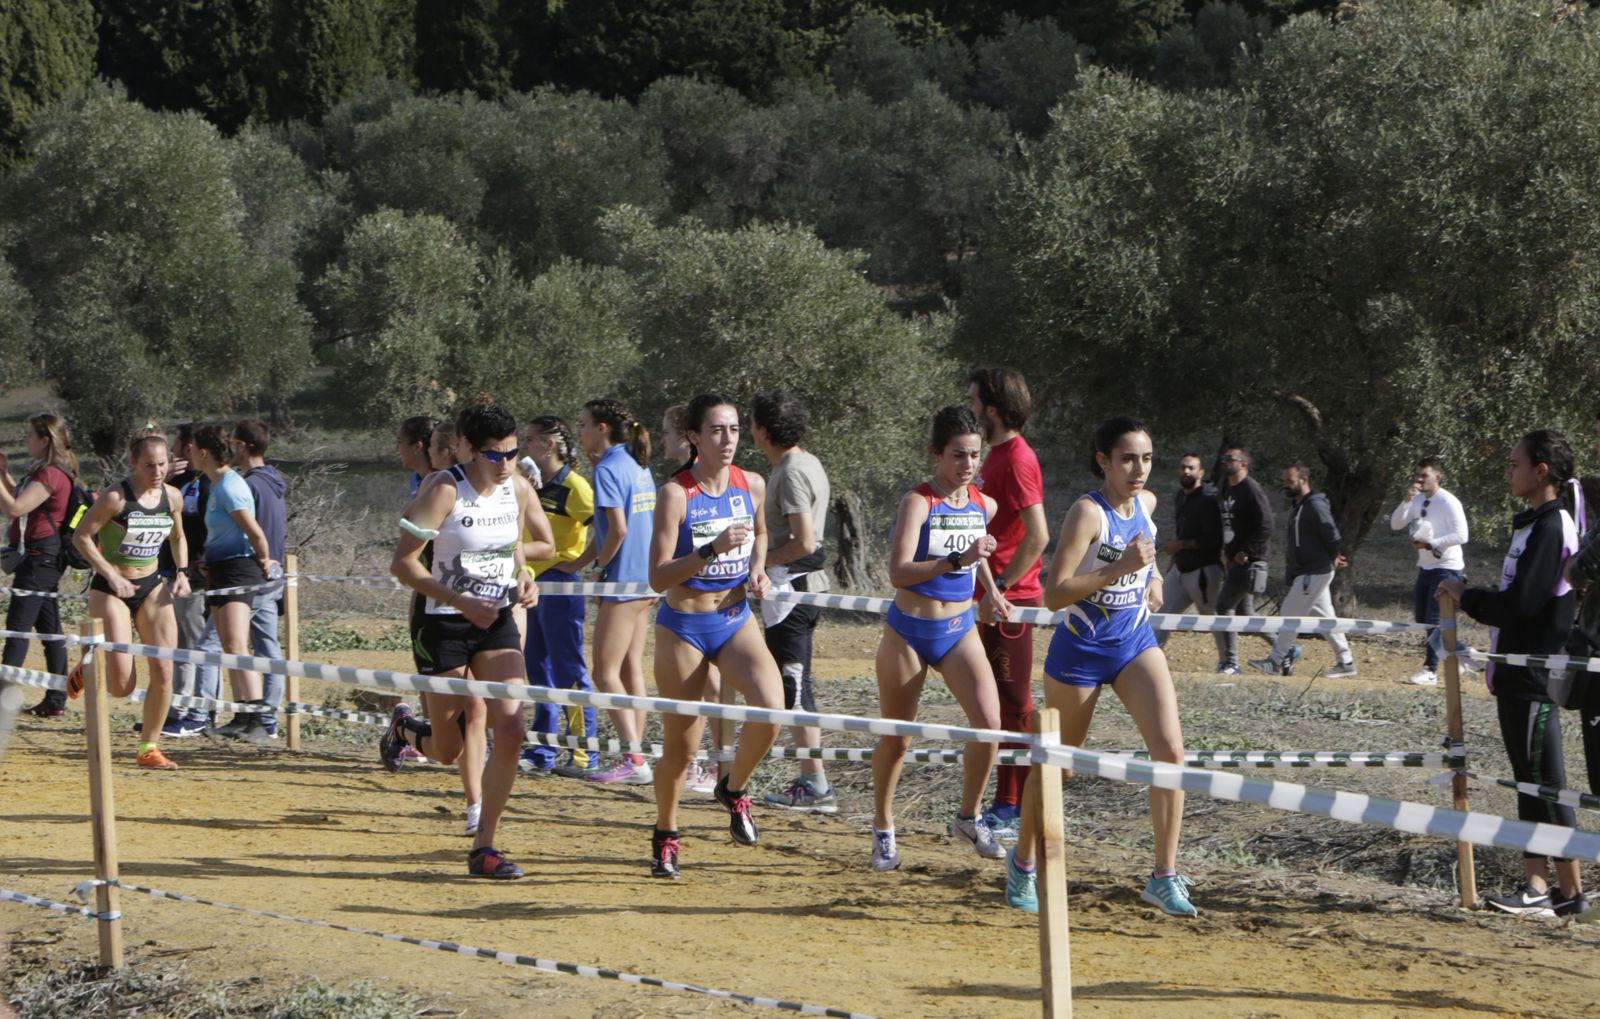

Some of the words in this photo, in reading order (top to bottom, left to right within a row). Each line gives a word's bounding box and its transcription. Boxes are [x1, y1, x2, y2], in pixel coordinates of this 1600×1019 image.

[135, 531, 163, 543] 472
[944, 534, 976, 551] 409
[1100, 546, 1122, 560] DIPUTA
[479, 563, 504, 580] 534
[1091, 590, 1137, 605] Joma
